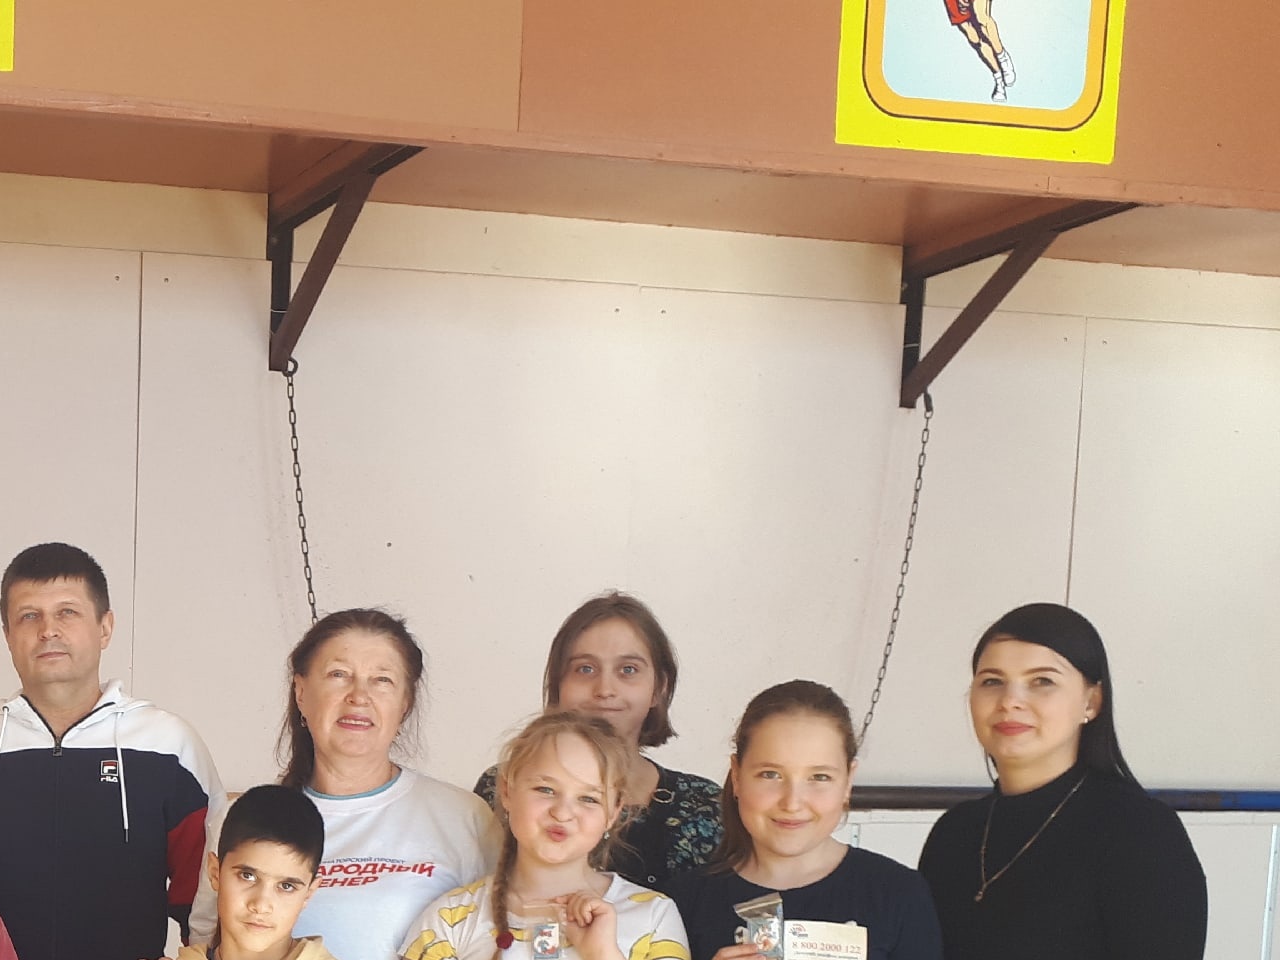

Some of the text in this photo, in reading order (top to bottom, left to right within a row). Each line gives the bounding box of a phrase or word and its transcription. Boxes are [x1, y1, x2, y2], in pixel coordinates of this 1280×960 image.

[316, 862, 436, 877] АРОДНЫЙ
[319, 876, 379, 888] ЕНЕР
[820, 943, 842, 952] 2000
[845, 945, 862, 954] 122
